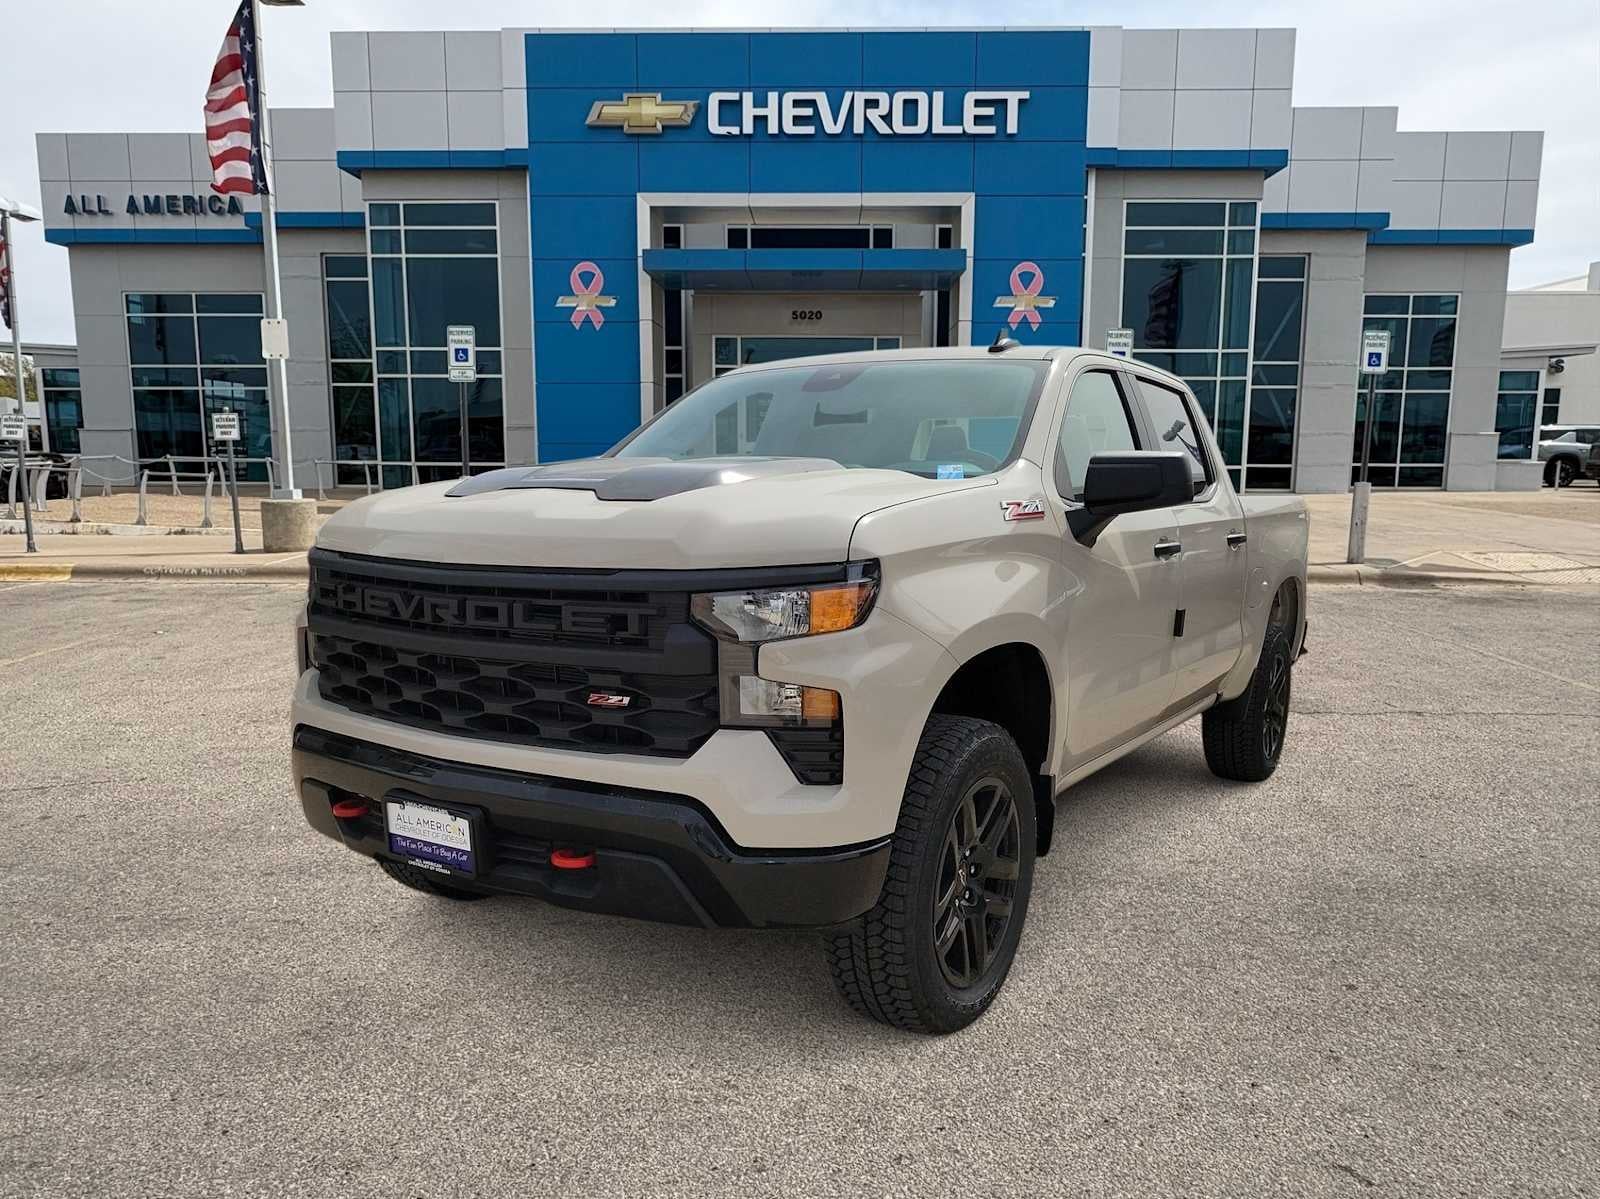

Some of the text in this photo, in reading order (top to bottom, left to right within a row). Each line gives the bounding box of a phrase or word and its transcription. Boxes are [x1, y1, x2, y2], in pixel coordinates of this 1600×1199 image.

[707, 91, 1030, 135] CHEVROLET
[64, 194, 112, 215] ALL
[791, 310, 823, 320] 5020
[316, 580, 659, 637] CHEVROLET
[396, 812, 414, 825] ALL
